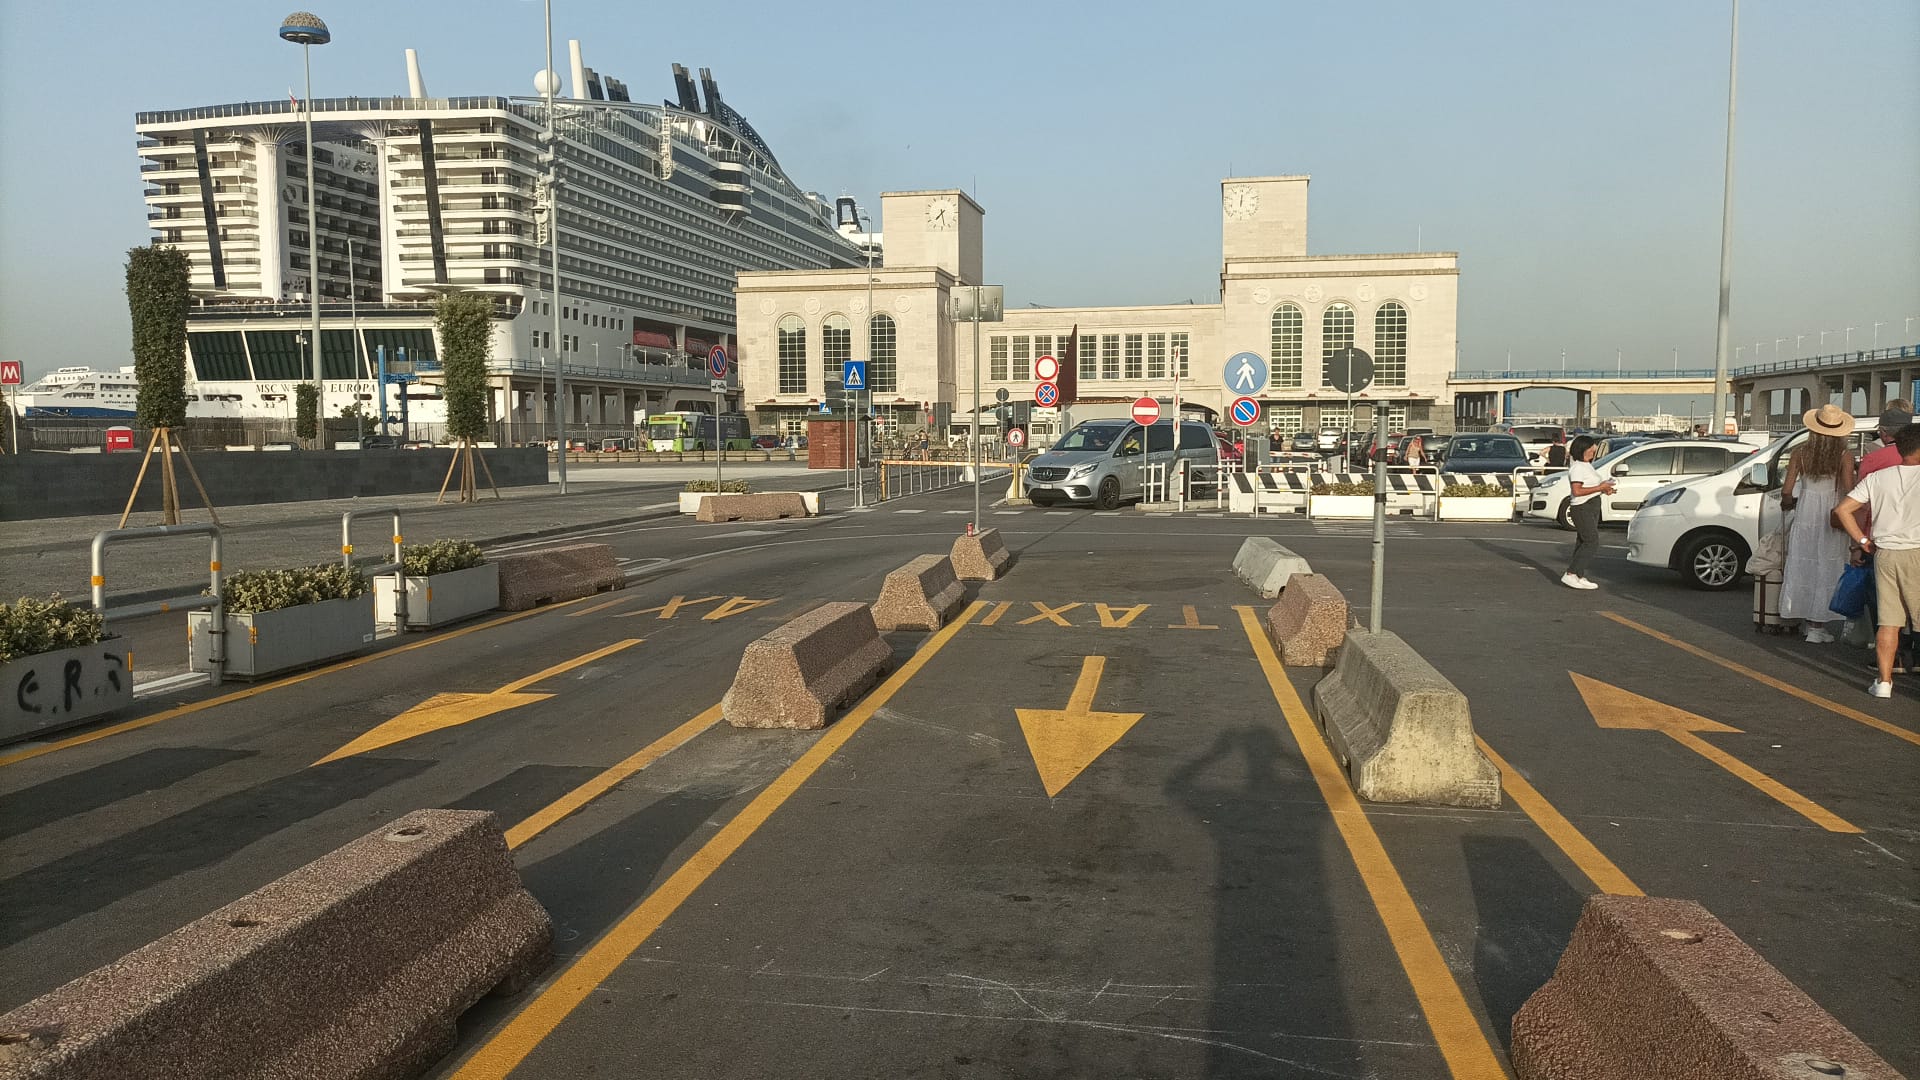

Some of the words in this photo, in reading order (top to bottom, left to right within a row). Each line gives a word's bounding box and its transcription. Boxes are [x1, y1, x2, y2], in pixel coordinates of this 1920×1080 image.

[3, 365, 19, 380] M
[255, 383, 278, 394] MSC
[330, 383, 376, 394] EUROPA
[979, 600, 1220, 630] TAXI
